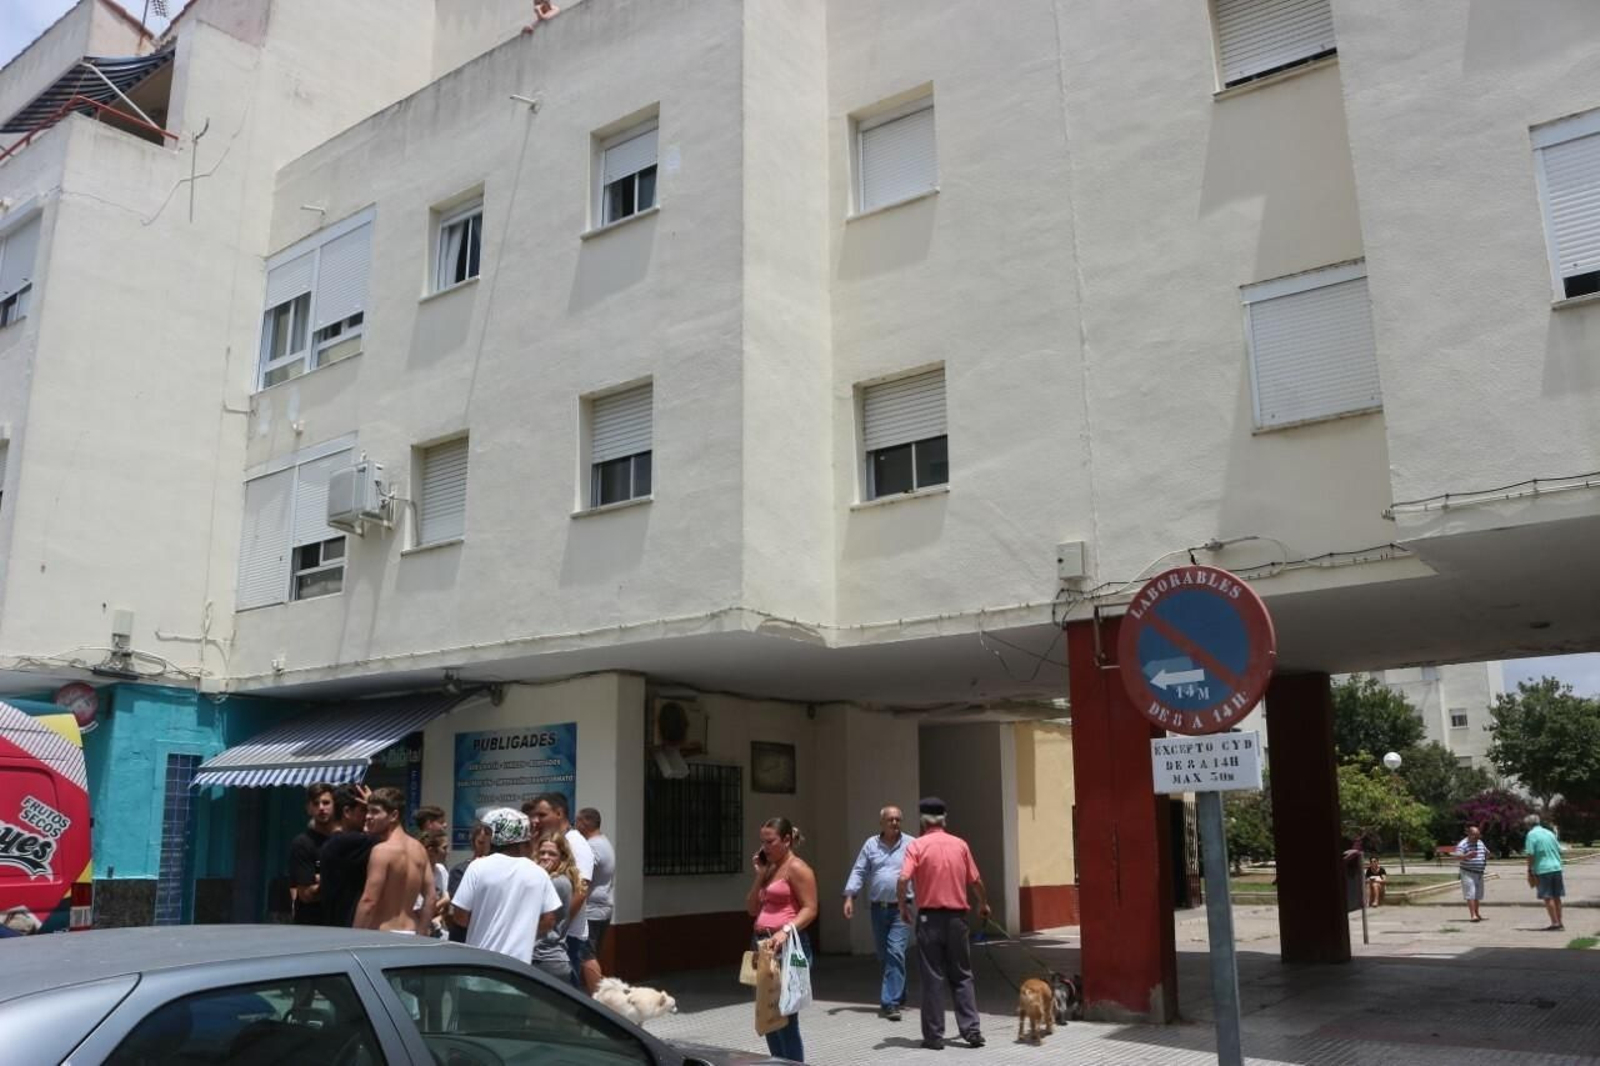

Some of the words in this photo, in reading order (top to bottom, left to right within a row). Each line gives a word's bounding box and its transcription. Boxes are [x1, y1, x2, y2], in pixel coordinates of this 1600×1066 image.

[1130, 570, 1241, 620] LABORABLES
[1148, 700, 1170, 722] DE
[1172, 711, 1182, 726] 8
[1192, 716, 1203, 729] A
[473, 732, 557, 751] PUBLIGADES
[1154, 741, 1214, 756] EXCEPTO
[1221, 739, 1252, 751] CYD
[1166, 760, 1182, 770] DE
[1187, 759, 1196, 769] 8
[1200, 759, 1208, 769] A
[1213, 756, 1239, 768] 14H
[1172, 773, 1202, 784] MAX
[21, 809, 61, 838] SECOS
[24, 798, 68, 828] FRUTOS
